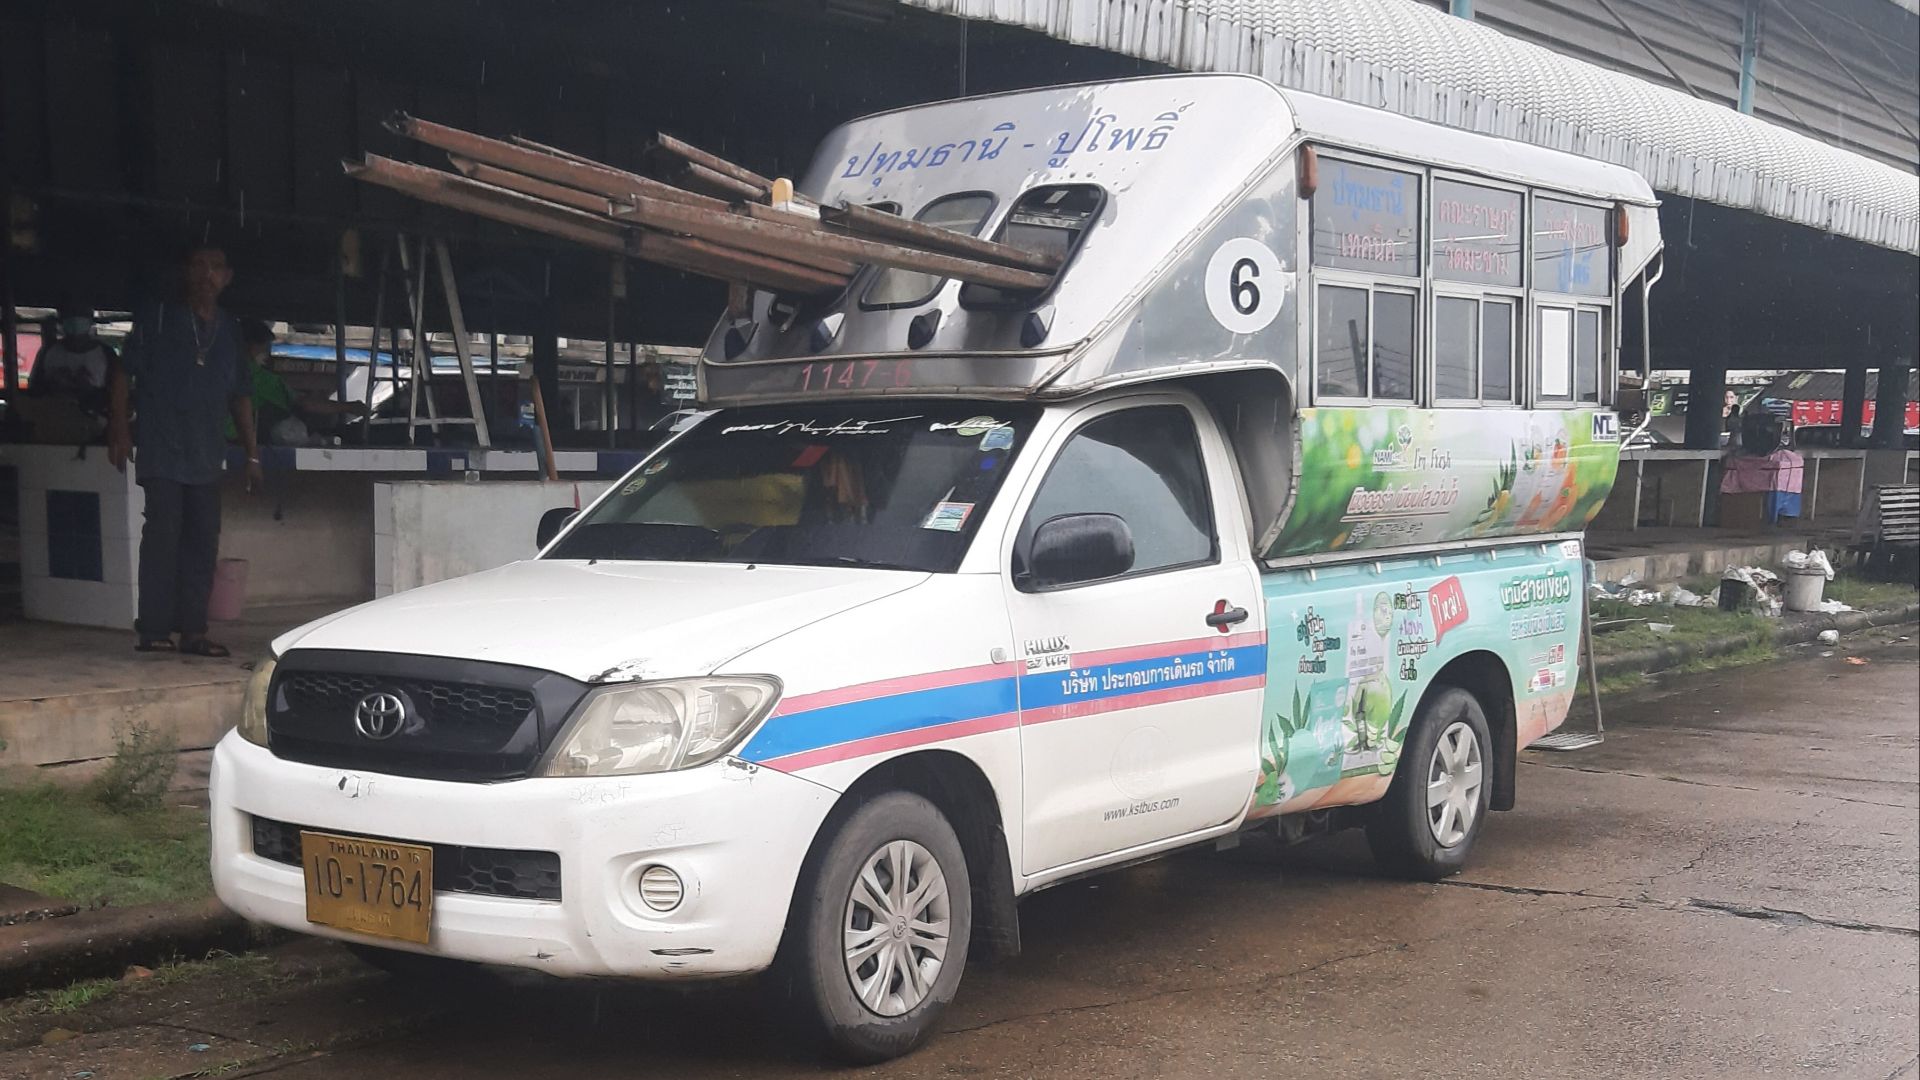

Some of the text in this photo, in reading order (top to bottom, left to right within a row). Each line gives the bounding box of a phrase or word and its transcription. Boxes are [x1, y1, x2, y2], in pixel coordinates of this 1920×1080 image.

[841, 121, 1017, 188] ปทุมธานี
[1047, 101, 1196, 169] ปู่โพธิ์
[1229, 257, 1261, 316] 6
[802, 359, 913, 392] 1147-6
[1023, 635, 1070, 656] HILUX
[1061, 650, 1236, 695] บริษัท ประกอบการเดินรถ จำกัด
[1103, 797, 1180, 822] www.kstbus.com
[328, 840, 400, 862] THAILAND
[314, 855, 423, 913] 10-1764
